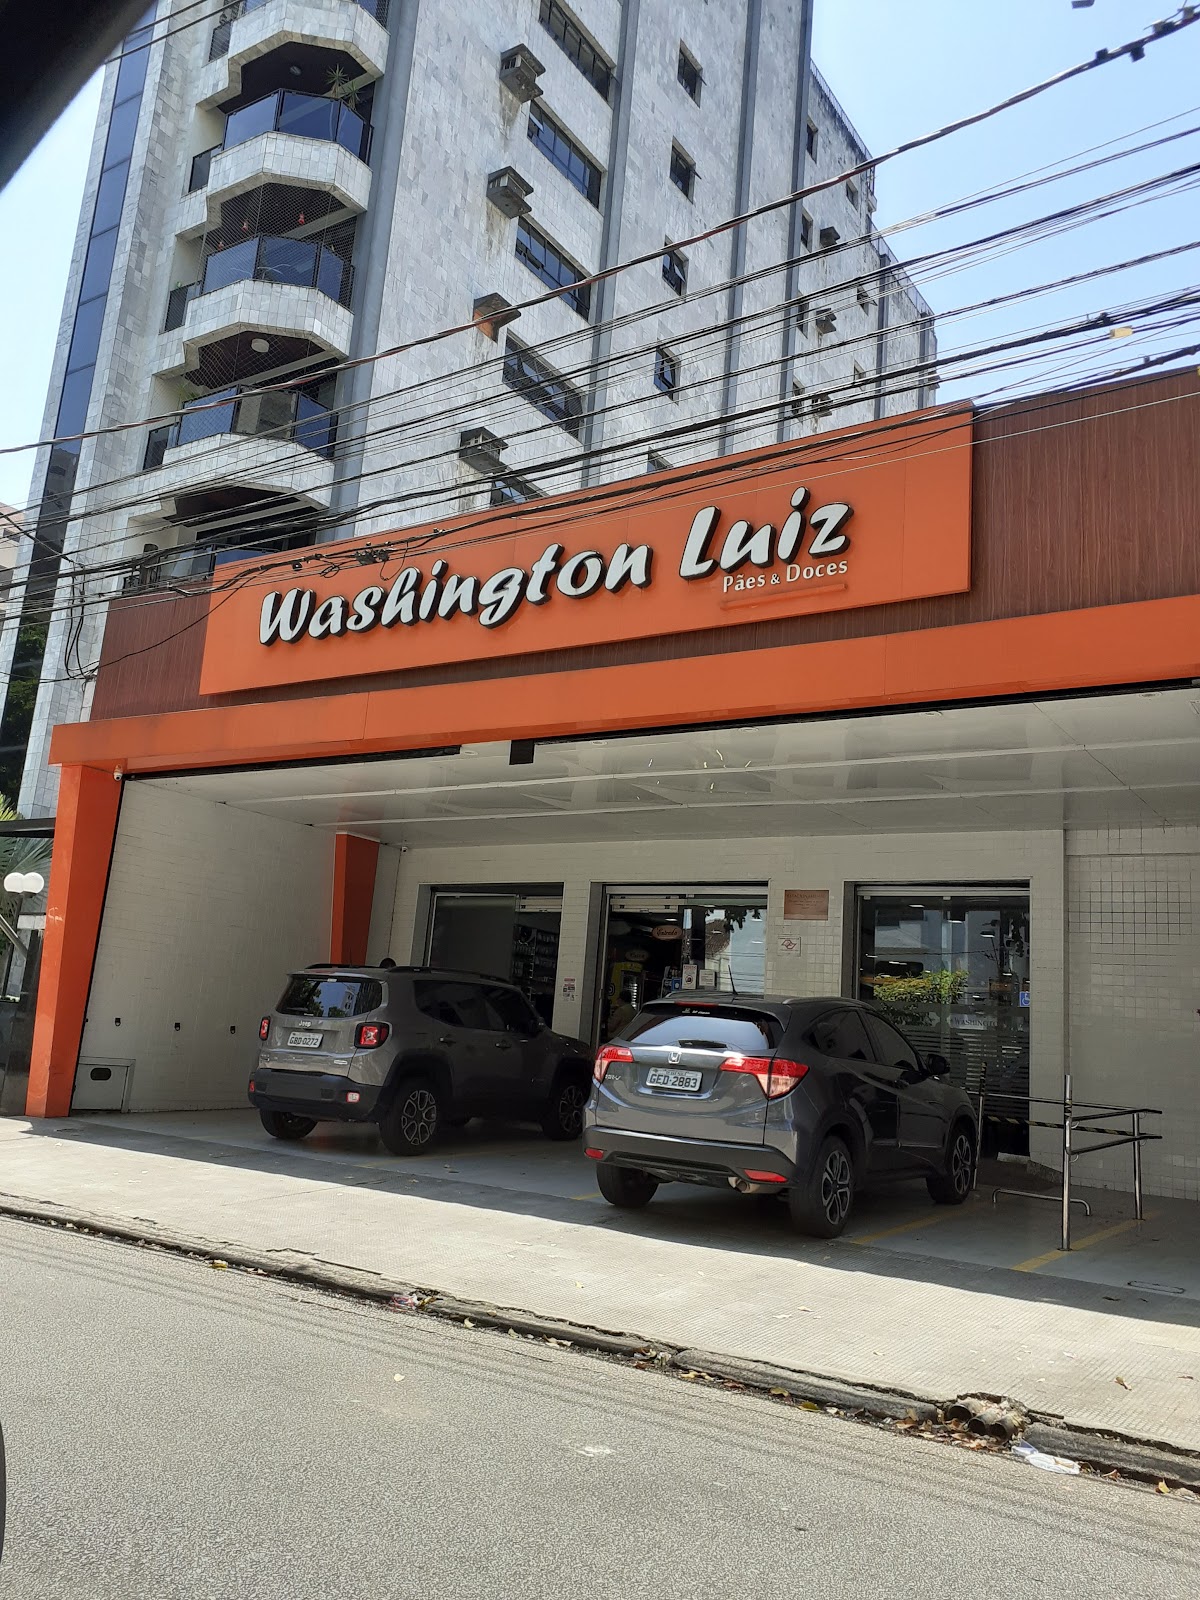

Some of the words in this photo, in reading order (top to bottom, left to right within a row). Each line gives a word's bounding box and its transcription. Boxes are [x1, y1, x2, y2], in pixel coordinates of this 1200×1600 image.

[259, 543, 654, 647] Washington
[679, 486, 854, 581] Luiz
[722, 573, 766, 593] Pães
[770, 573, 781, 585] &
[785, 560, 848, 582] Doces
